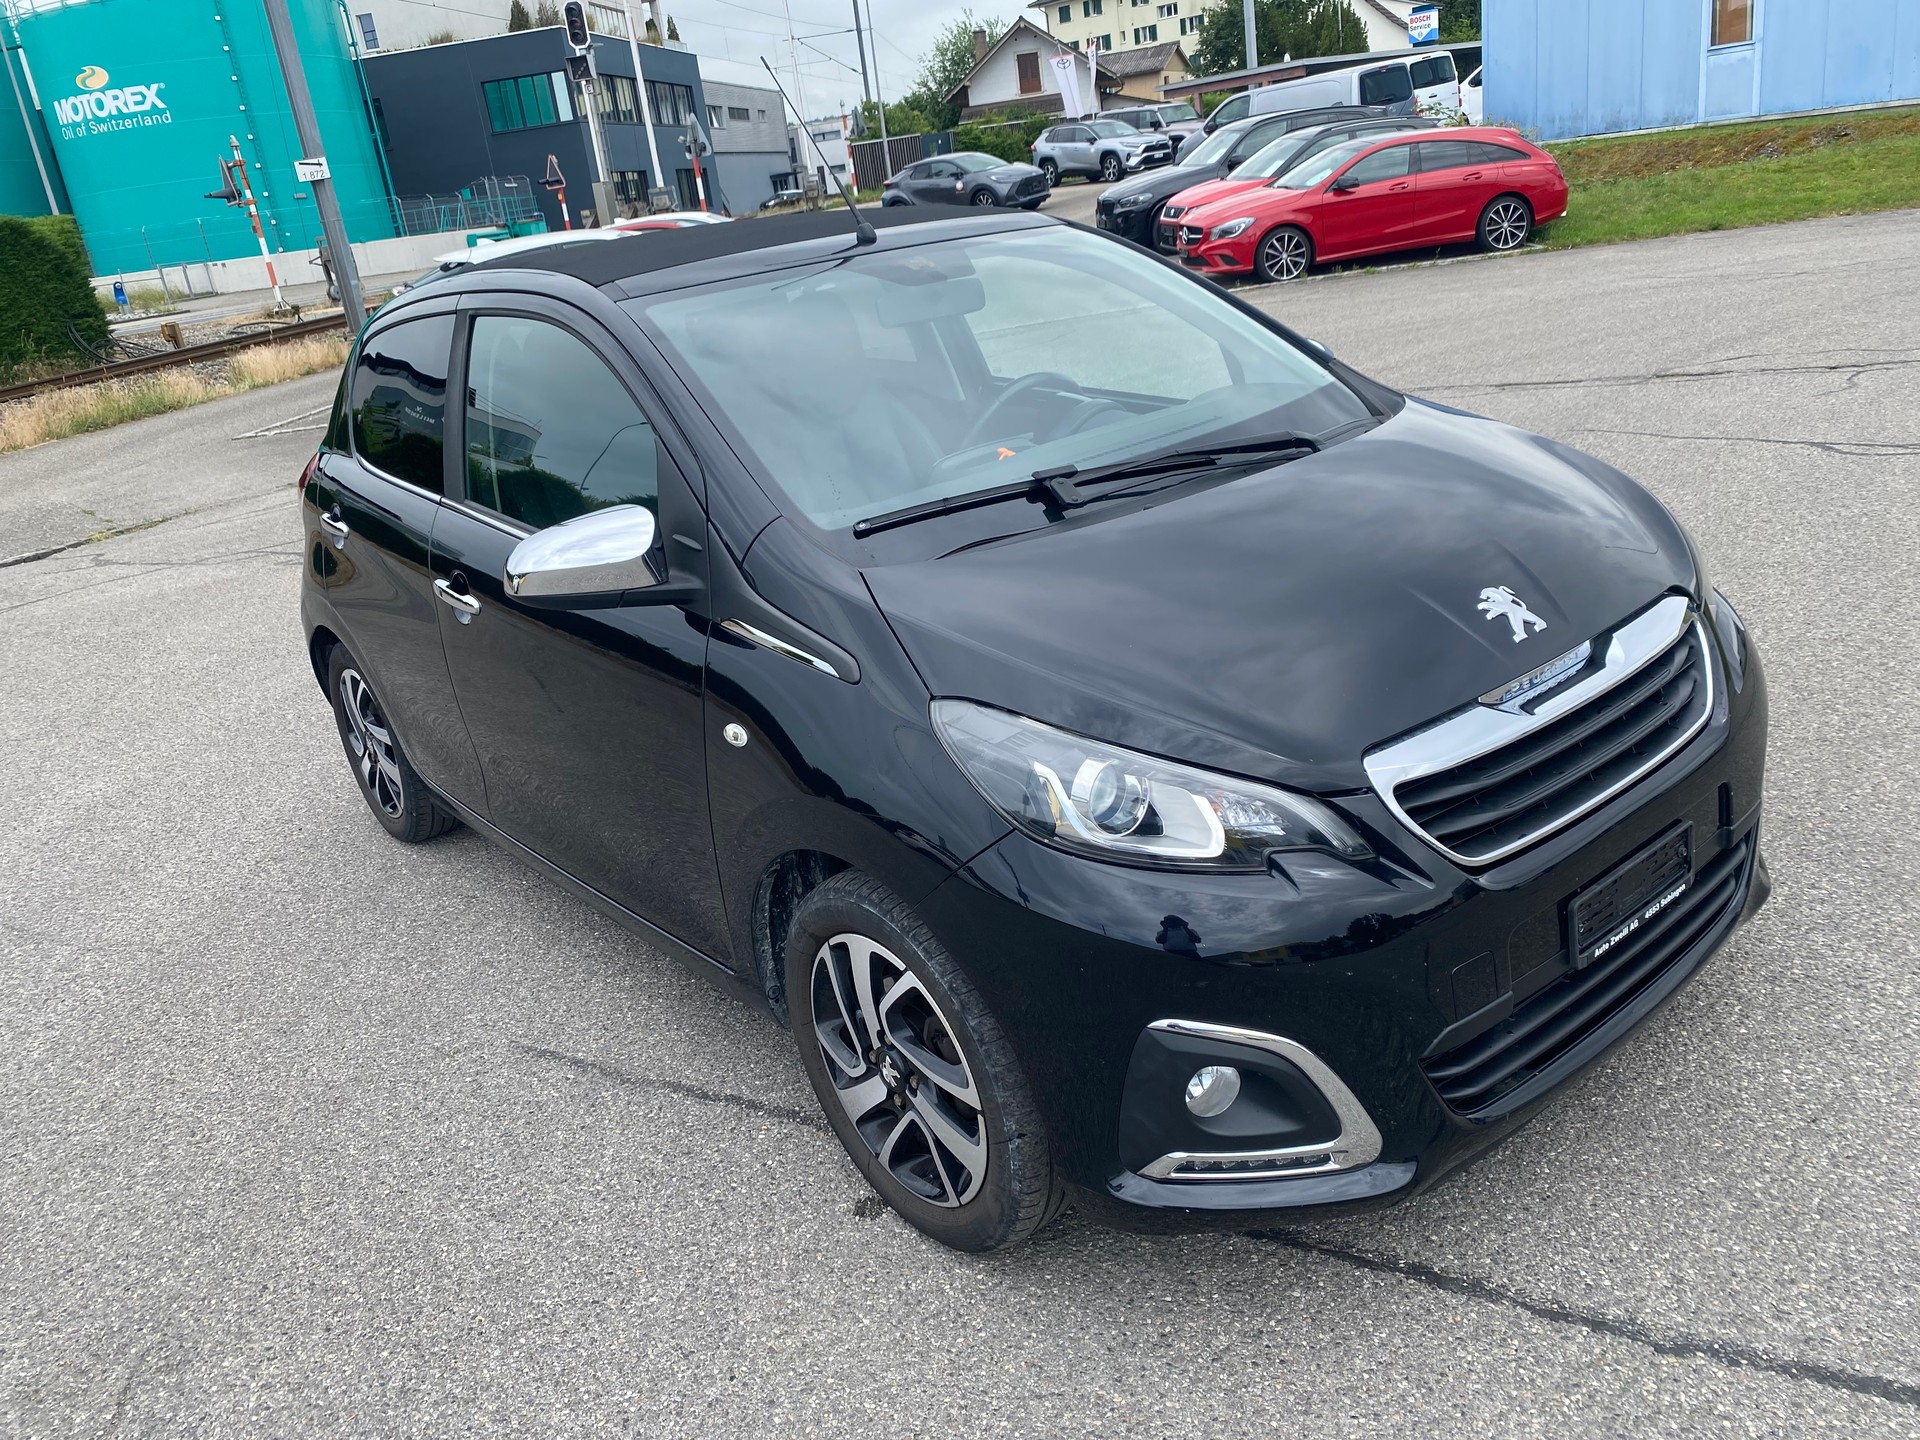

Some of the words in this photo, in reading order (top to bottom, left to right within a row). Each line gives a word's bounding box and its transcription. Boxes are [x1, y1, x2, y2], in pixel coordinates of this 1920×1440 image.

[1410, 14, 1431, 24] BOSCH
[1410, 23, 1431, 31] Service
[53, 83, 167, 126] MOTOREX
[61, 126, 75, 140] Oil
[76, 123, 87, 137] of
[88, 110, 172, 135] Switzerland
[1594, 942, 1610, 958] Auto
[1629, 919, 1639, 932] AG
[1644, 902, 1660, 919] 4553
[1660, 883, 1686, 907] Subingen
